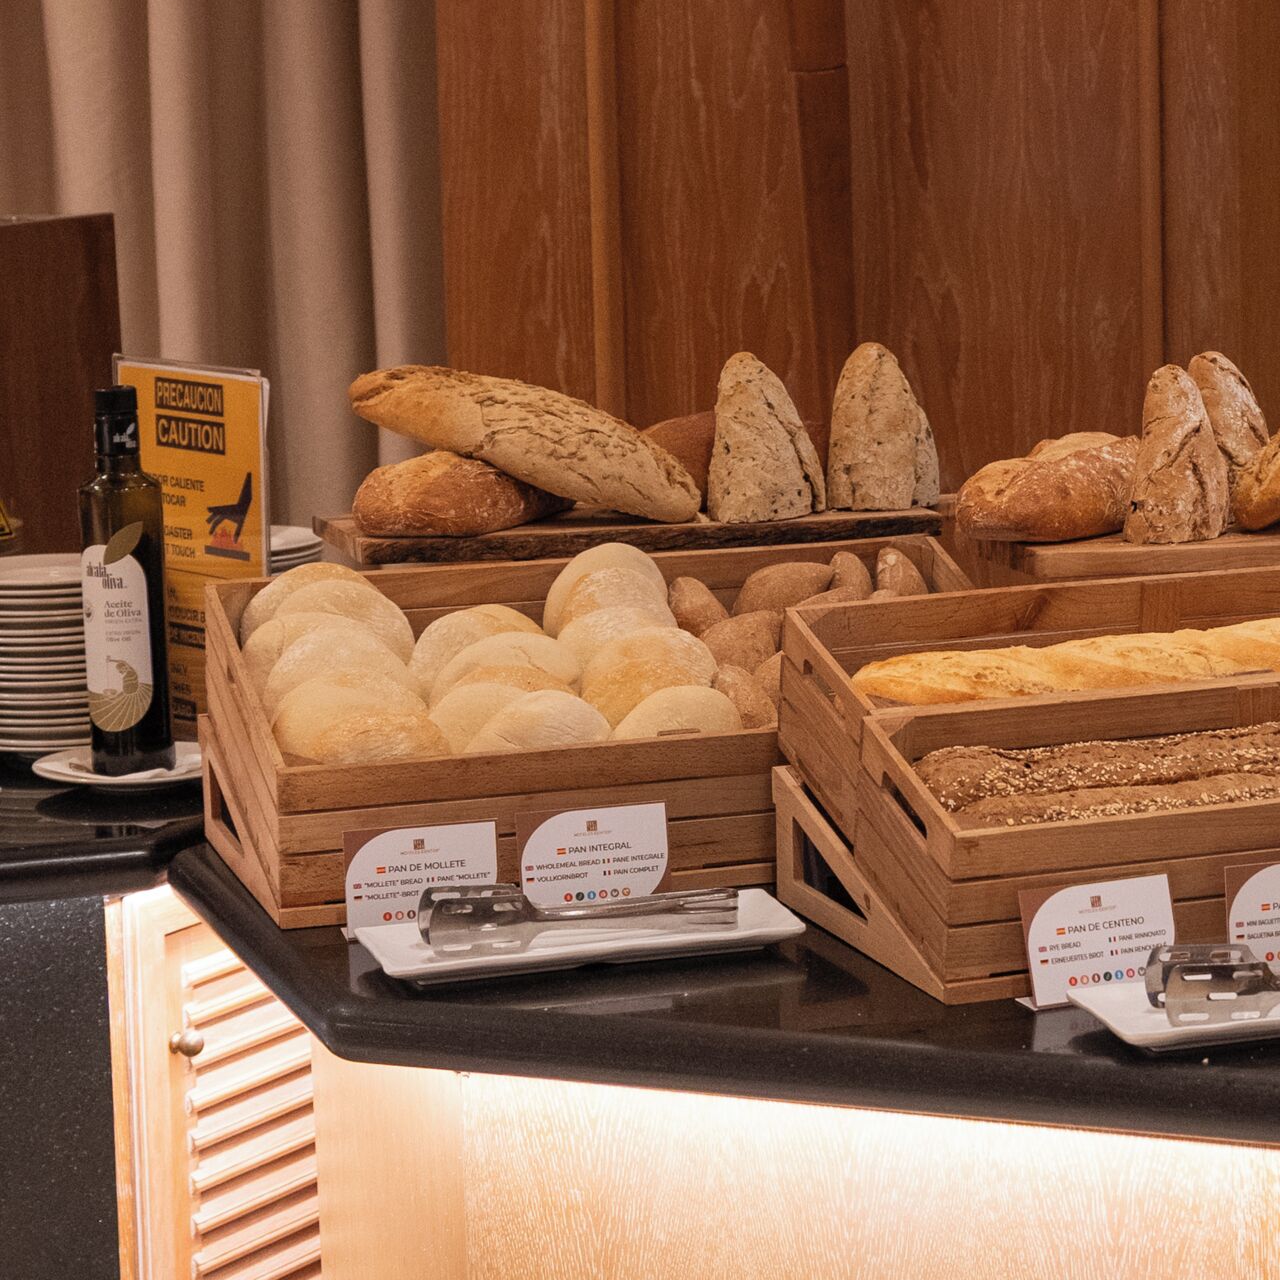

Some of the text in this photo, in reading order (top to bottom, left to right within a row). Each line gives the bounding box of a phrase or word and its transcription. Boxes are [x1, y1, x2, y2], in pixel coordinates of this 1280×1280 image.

[157, 382, 222, 414] PRECAUCION
[158, 418, 224, 451] CAUTION
[169, 476, 205, 493] CALIENTE
[104, 600, 133, 609] Aceite
[104, 608, 142, 618] de Oliva
[568, 842, 632, 855] PAN INTEGRAL
[612, 852, 665, 864] PANE INTEGRALE
[388, 859, 466, 873] PAN DE MOLLETE
[536, 859, 601, 871] WHOLEMEAL BREAD
[613, 865, 659, 876] PAIN COMPLET
[400, 877, 423, 886] BREAD
[437, 874, 454, 882] PANE
[536, 872, 588, 883] VOLLKORNBROT
[1068, 916, 1145, 934] PAN DE CENTENO
[1119, 929, 1167, 942] PANE RINNOVATO
[1247, 931, 1274, 940] BAGUETINA
[1049, 941, 1081, 951] RYE BREAD
[1120, 947, 1134, 955] PAIN
[1088, 951, 1104, 959] BROT
